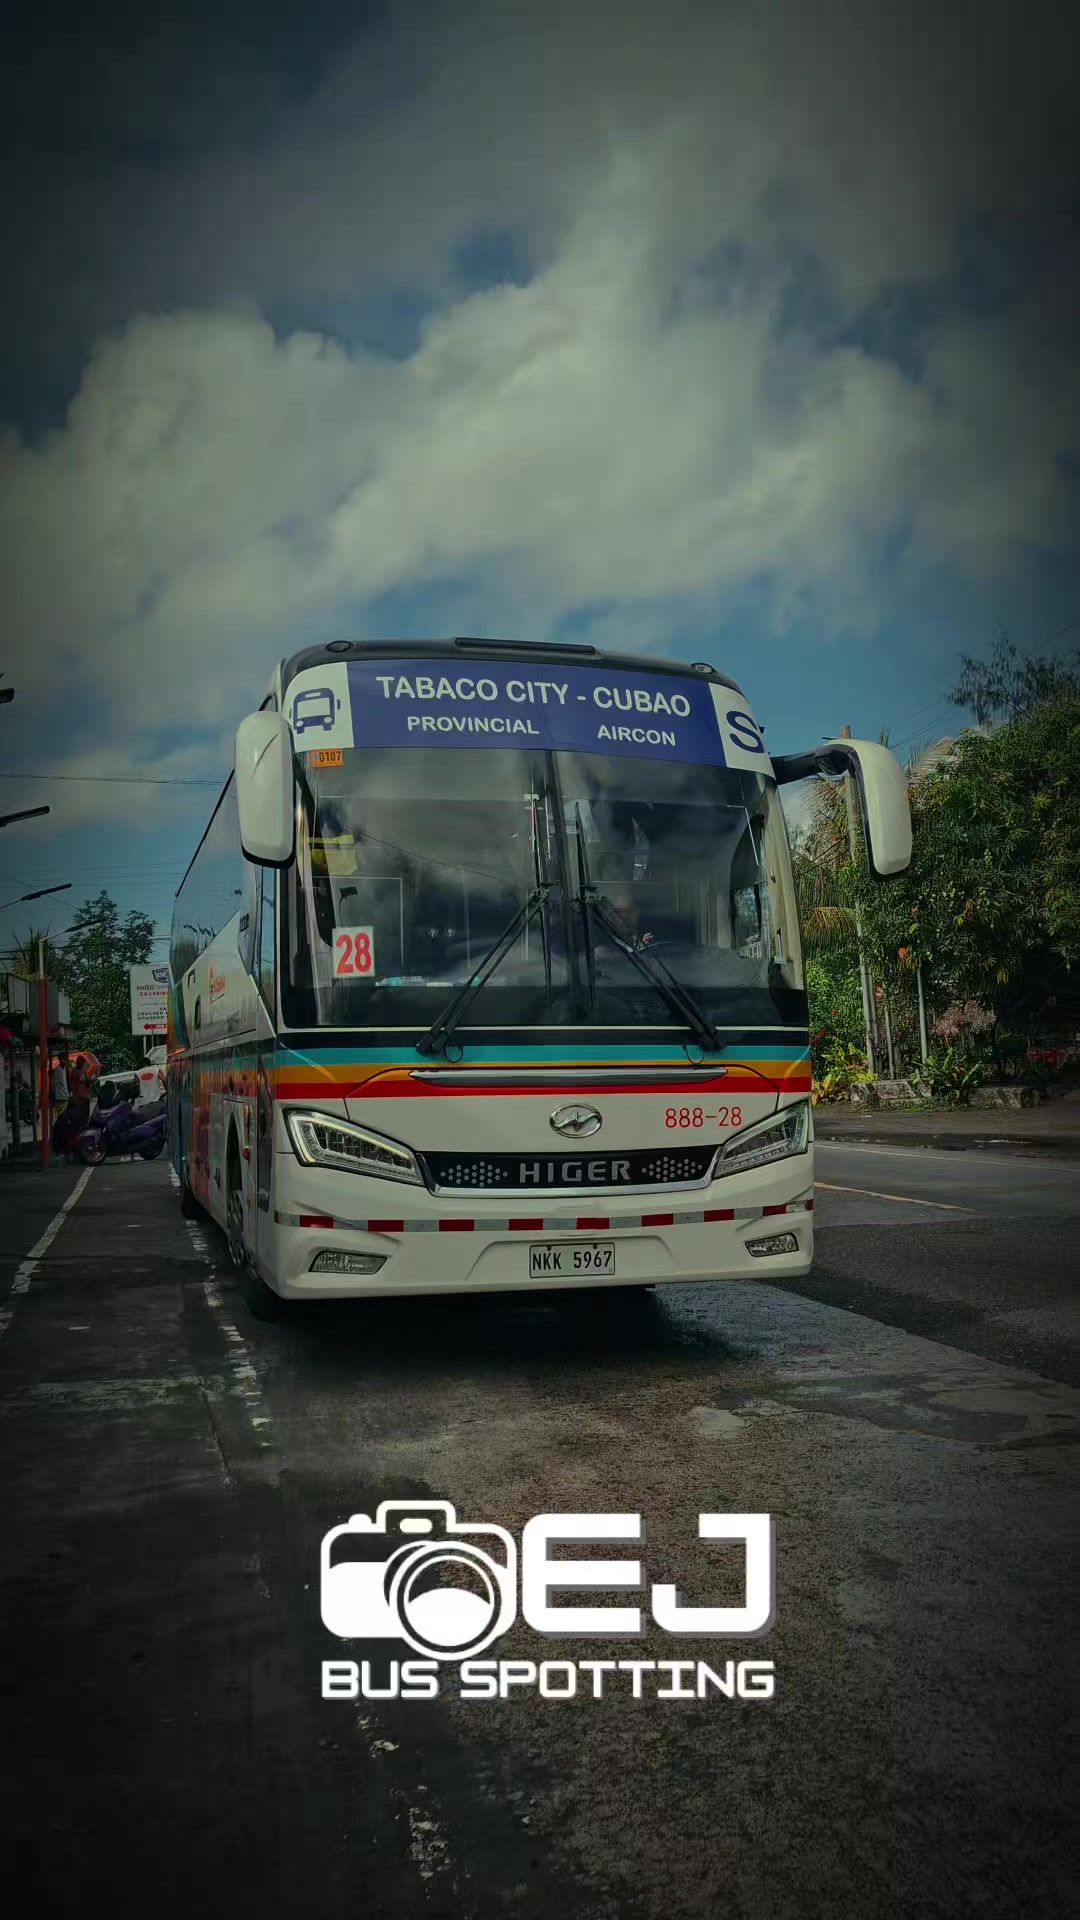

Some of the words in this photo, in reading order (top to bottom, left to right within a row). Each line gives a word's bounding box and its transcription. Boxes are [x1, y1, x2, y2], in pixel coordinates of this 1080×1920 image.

[375, 676, 499, 702] TABACO
[506, 680, 570, 706] CITY
[592, 686, 692, 717] CUBAO
[407, 716, 540, 735] PROVINCIAL
[597, 724, 677, 746] AIRCON
[336, 932, 373, 974] 28
[664, 1105, 743, 1129] 888-28
[519, 1160, 631, 1184] HIGER
[532, 1252, 562, 1271] NKK
[573, 1250, 613, 1269] 5967
